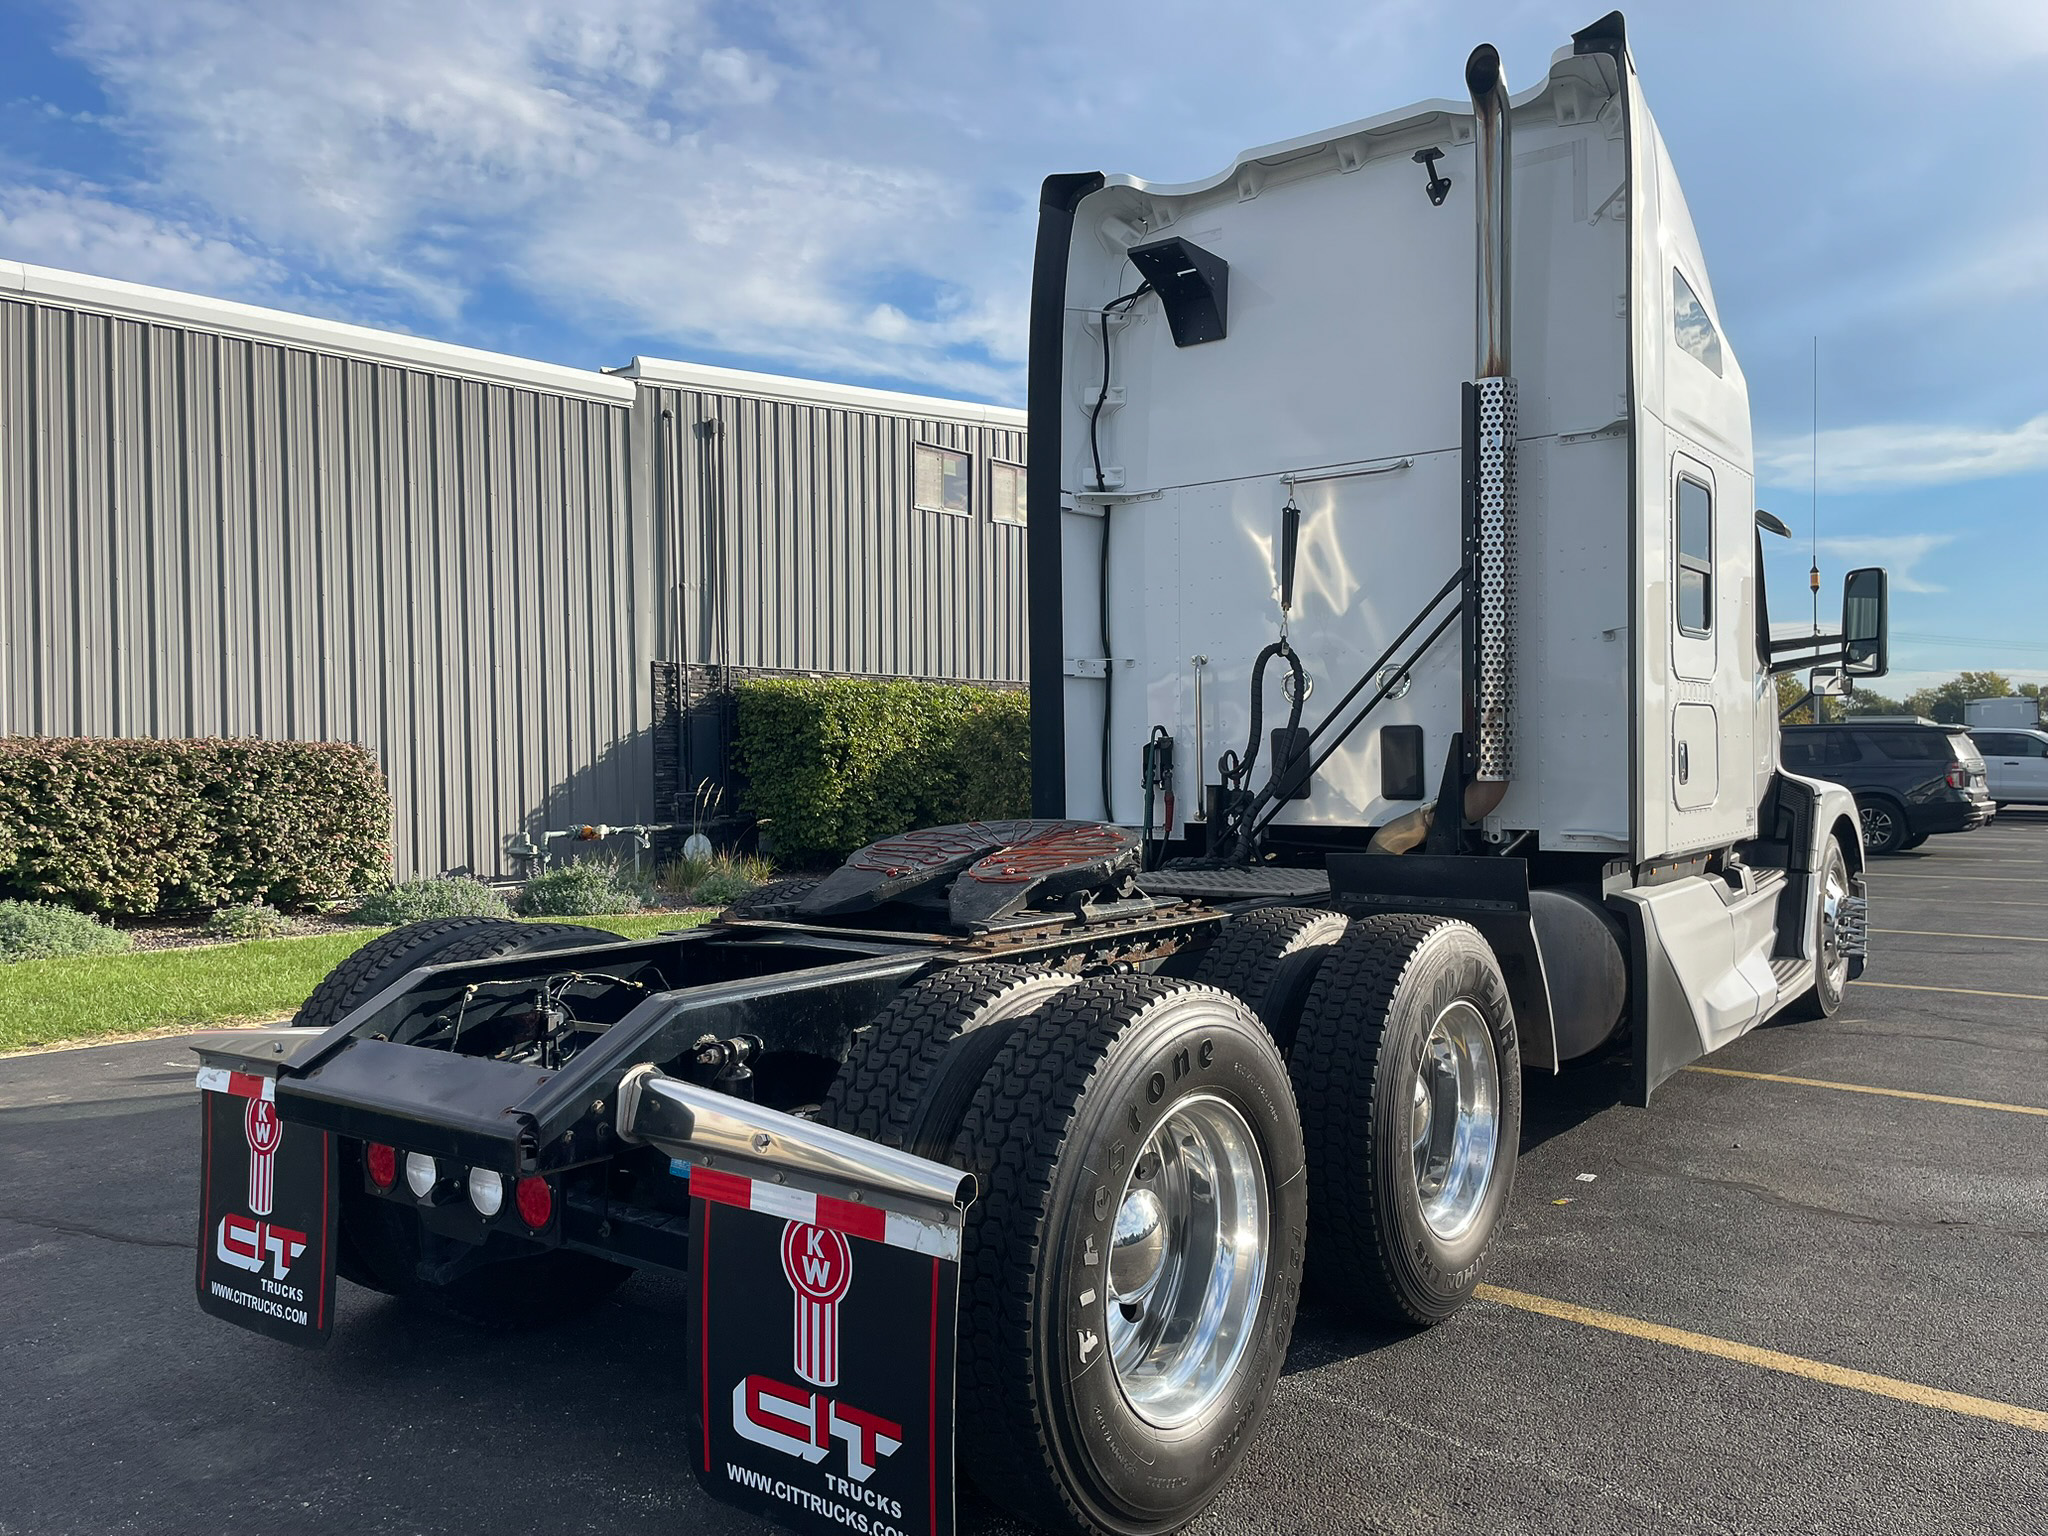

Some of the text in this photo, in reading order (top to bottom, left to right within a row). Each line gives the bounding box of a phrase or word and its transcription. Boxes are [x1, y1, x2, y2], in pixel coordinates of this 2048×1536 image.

[217, 1213, 307, 1281] CIT
[211, 1280, 308, 1326] WWW.CITTRUCKS.COM
[261, 1278, 304, 1302] TRUCKS
[732, 1374, 903, 1483] CIT
[825, 1472, 902, 1519] TRUCKS
